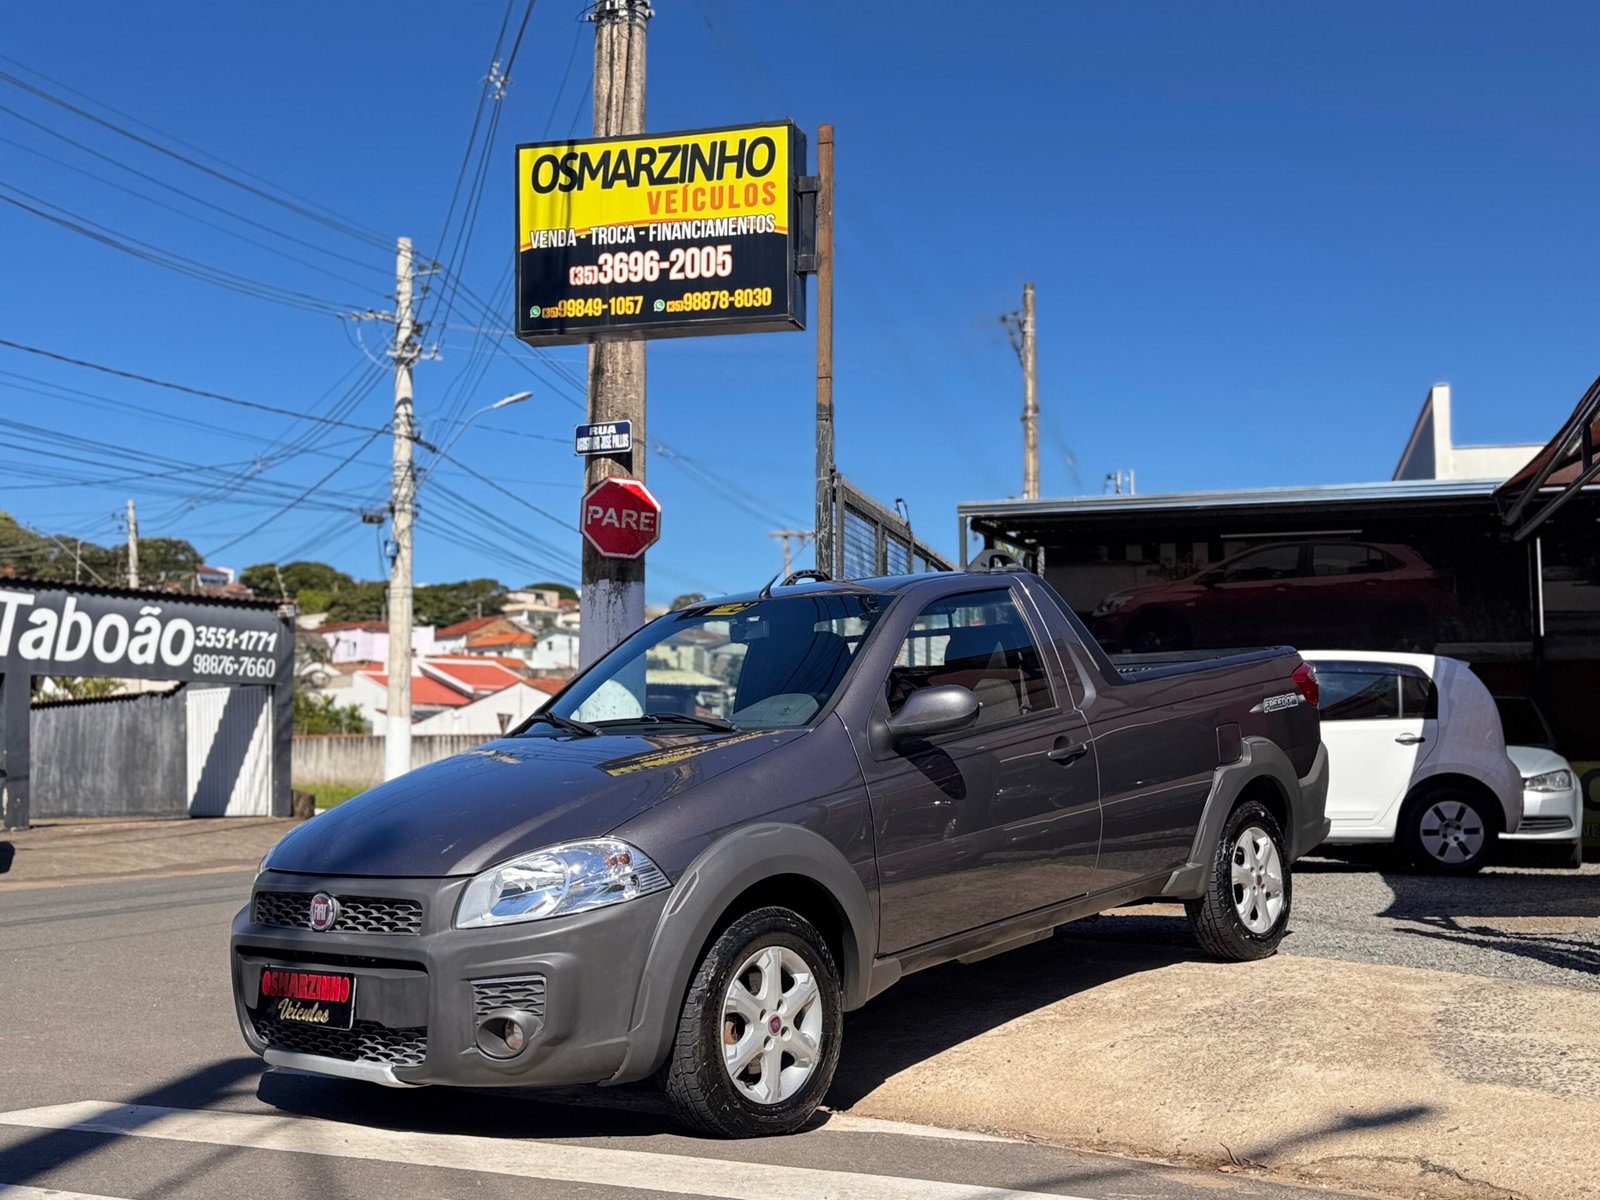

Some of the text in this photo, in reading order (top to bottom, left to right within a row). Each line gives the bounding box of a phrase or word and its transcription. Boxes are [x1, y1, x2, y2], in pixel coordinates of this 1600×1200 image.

[531, 136, 776, 194] OSMARZINHO
[647, 181, 776, 215] VEÍCULOS
[530, 228, 577, 249] VENDA
[591, 225, 636, 246] TROCA
[649, 214, 775, 242] FINANCIAMENTOS
[589, 425, 617, 436] RUA
[586, 505, 655, 532] PARE
[0, 590, 195, 666] Taboão
[1263, 692, 1299, 714] FREEDOM
[313, 903, 328, 920] FIAT
[261, 970, 350, 1003] OSMARZINHO
